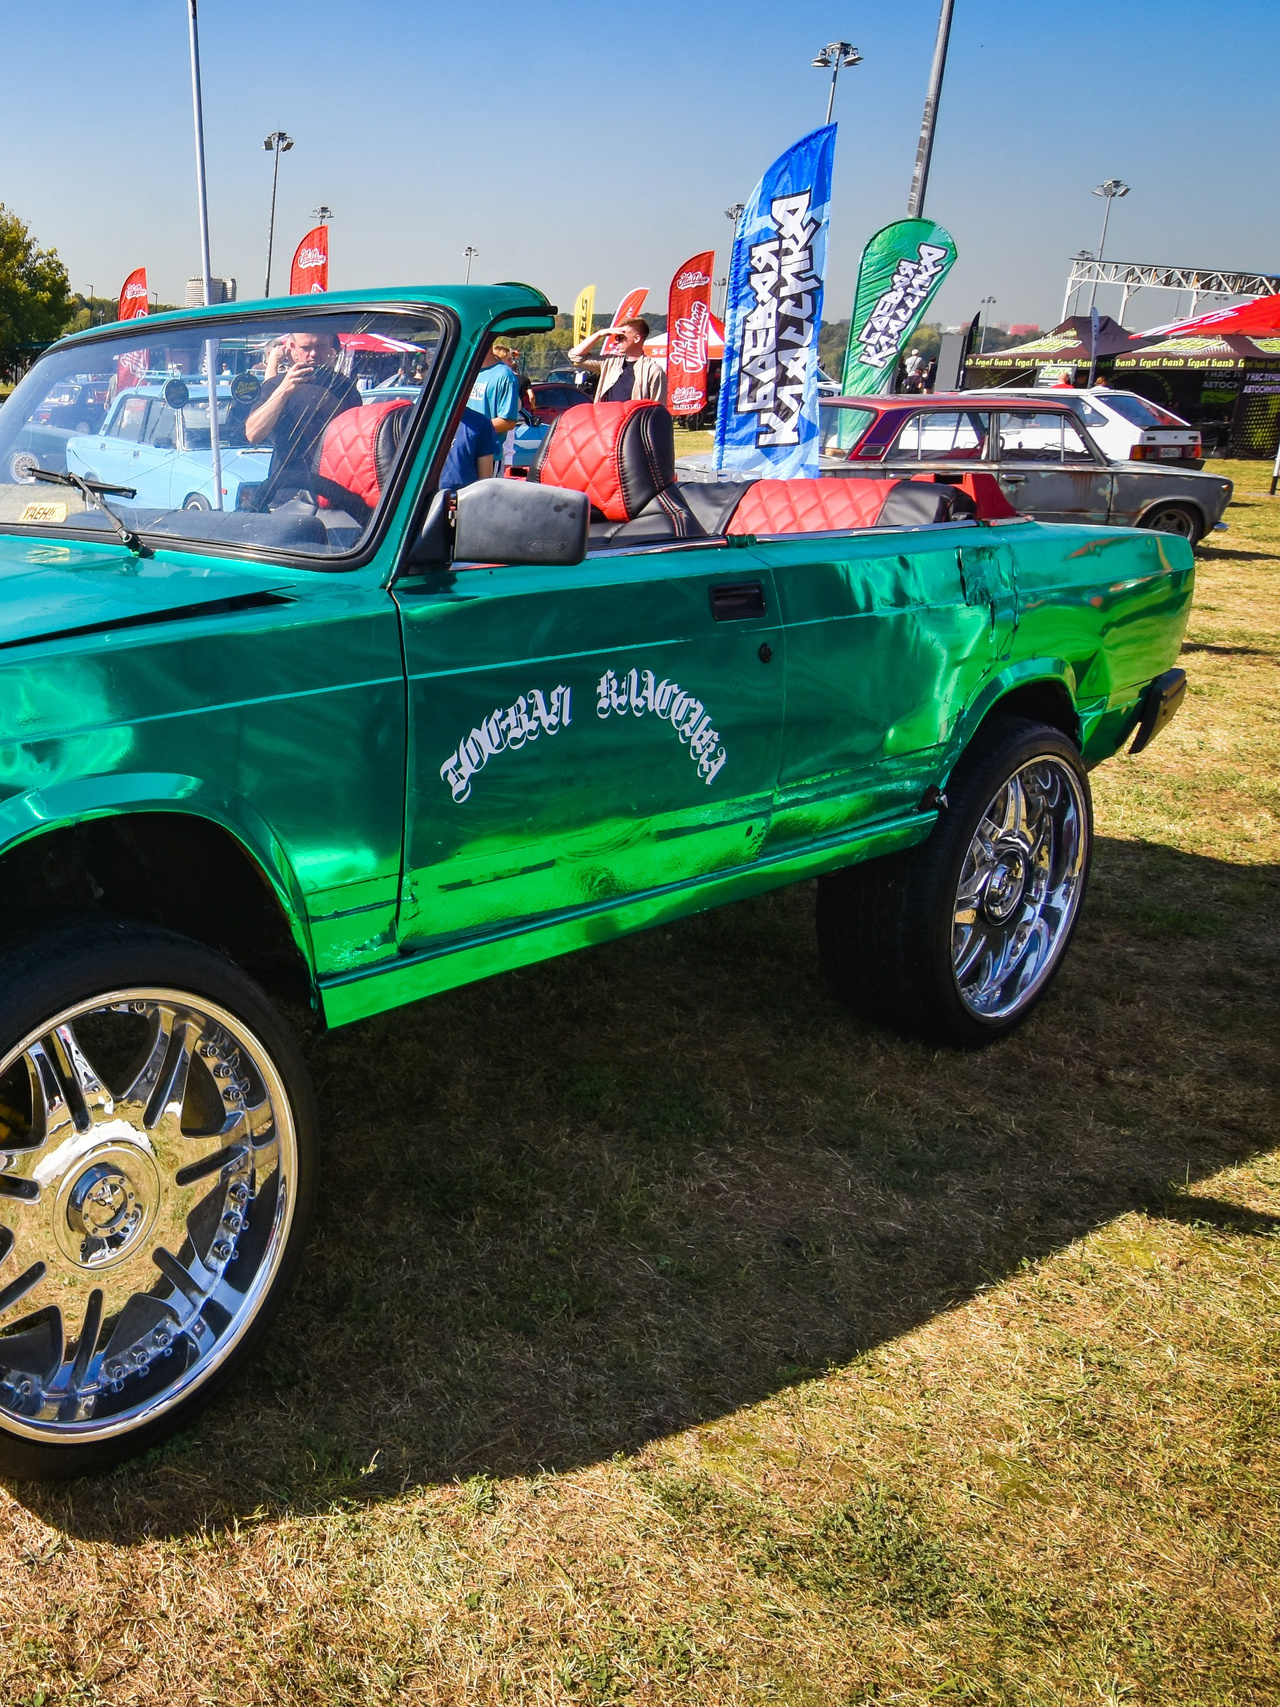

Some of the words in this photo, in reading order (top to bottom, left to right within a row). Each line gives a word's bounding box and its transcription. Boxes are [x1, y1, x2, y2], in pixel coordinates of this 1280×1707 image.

[579, 297, 588, 343] TELS
[737, 239, 780, 412] БОЕВАЯ
[759, 191, 821, 446] КЛАССИКА
[856, 258, 919, 345] БОЕВАЯ
[858, 242, 947, 368] КЛАССИКА
